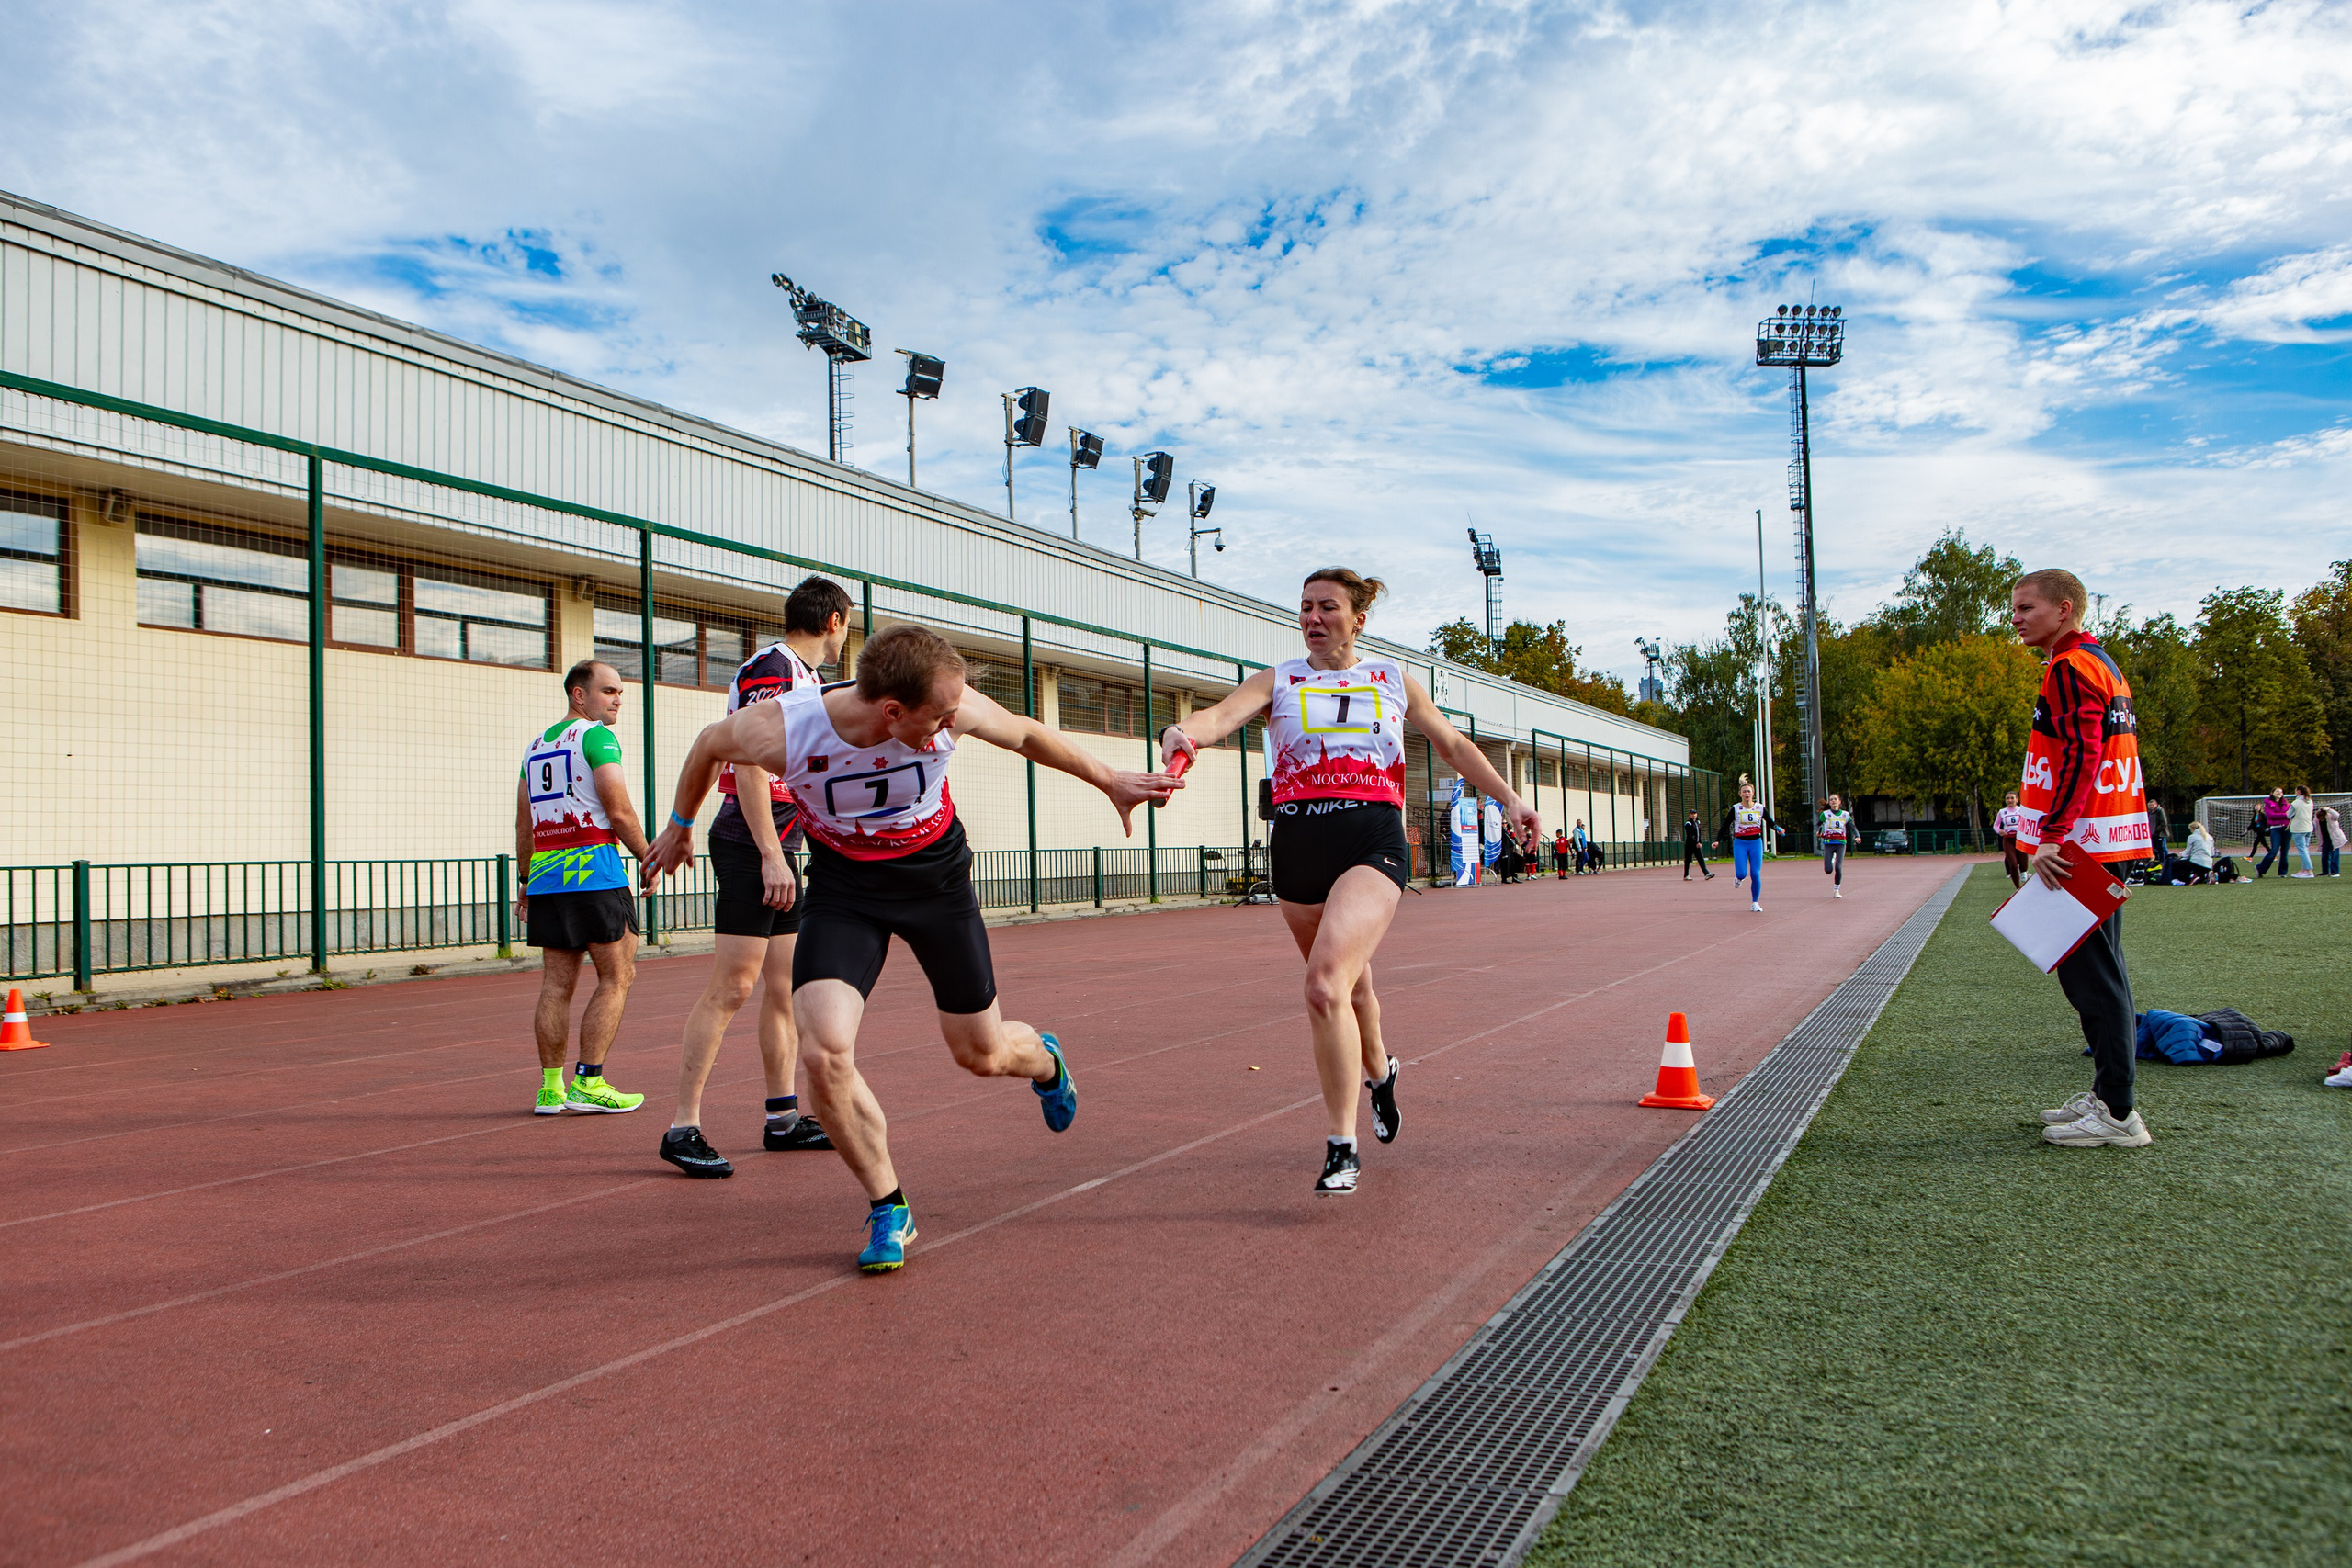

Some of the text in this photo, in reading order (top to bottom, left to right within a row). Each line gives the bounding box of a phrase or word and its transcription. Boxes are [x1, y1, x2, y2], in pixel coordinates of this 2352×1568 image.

[1331, 694, 1351, 723] 7
[1373, 722, 1381, 734] 3
[542, 762, 553, 792] 9
[1311, 773, 1404, 794] МОСКОМСПОРТ
[566, 784, 574, 797] 4
[865, 778, 889, 808] 7
[1306, 799, 1358, 816] NIKE
[1747, 813, 1753, 822] 6
[2109, 823, 2151, 843] МОСКОВ
